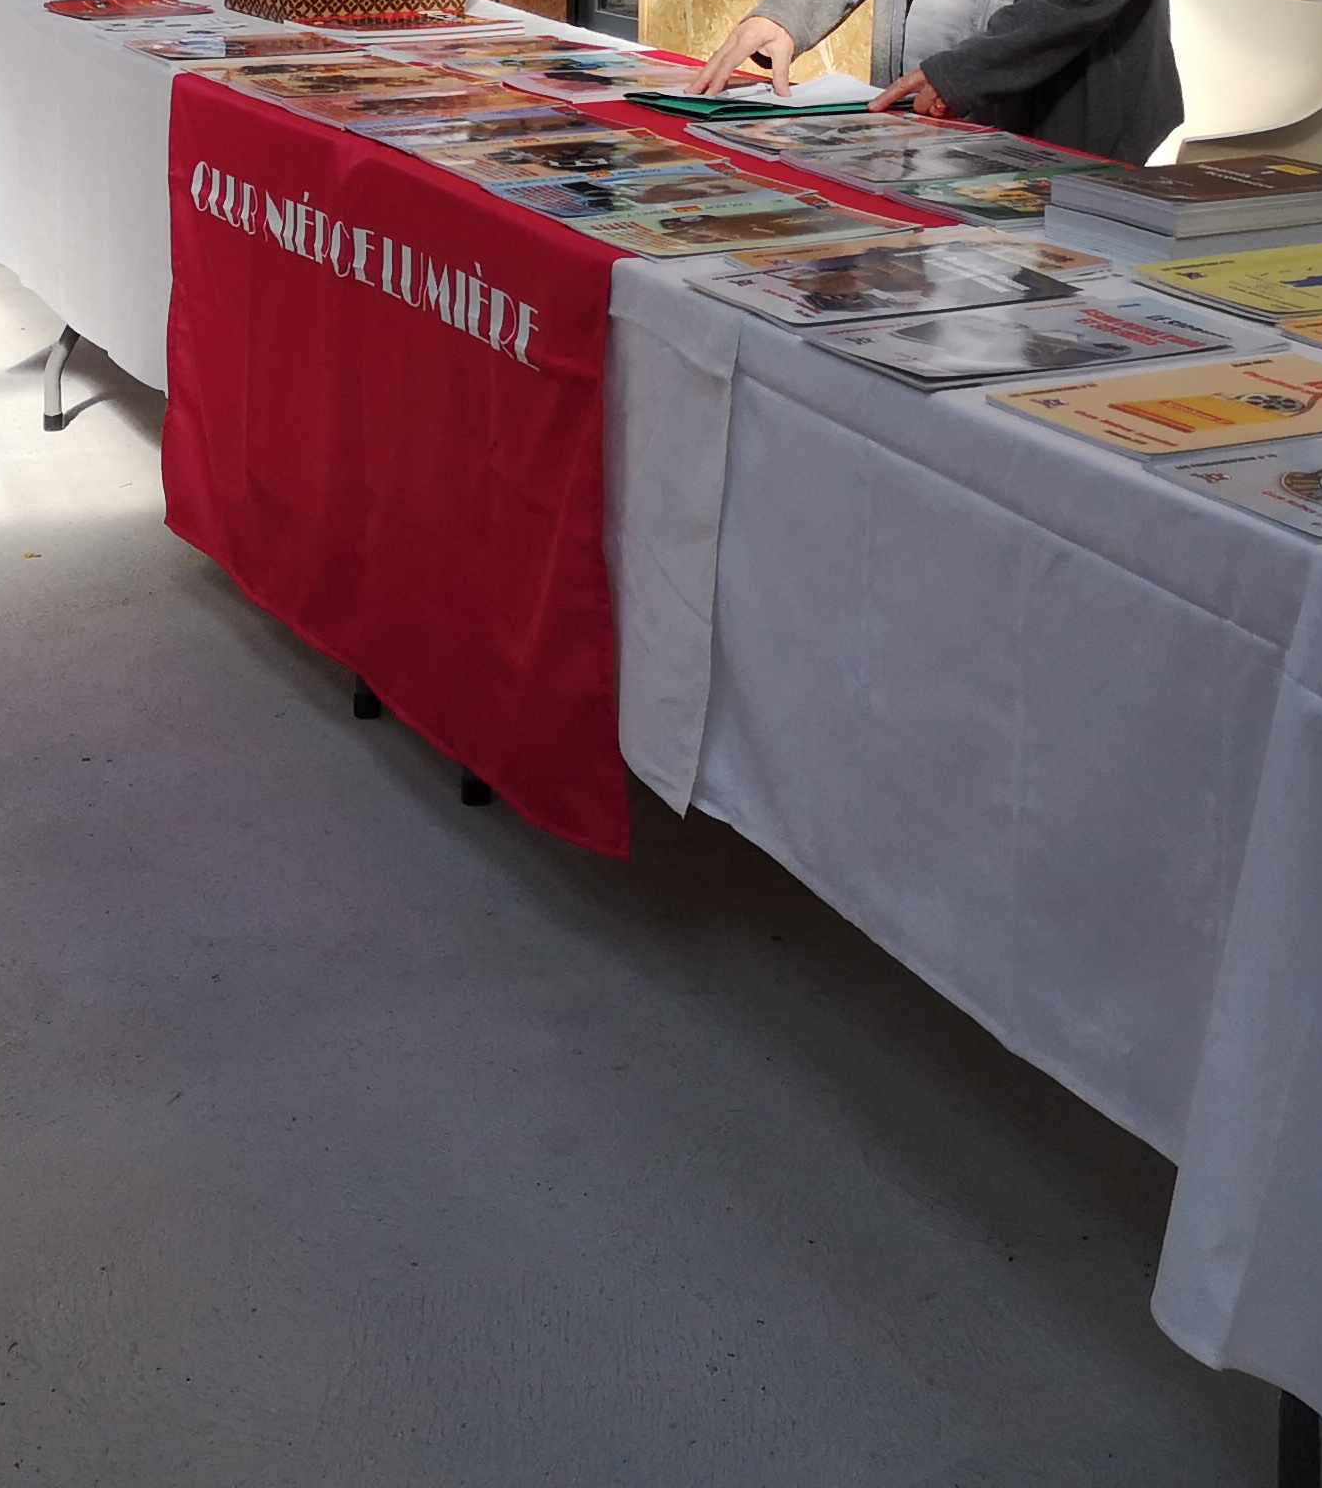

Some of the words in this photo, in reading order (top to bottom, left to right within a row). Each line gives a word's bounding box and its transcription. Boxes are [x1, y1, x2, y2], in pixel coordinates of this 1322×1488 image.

[190, 160, 257, 235] CLUB
[263, 191, 376, 287] NIÉPCE
[381, 236, 541, 371] LUMIÈRE
